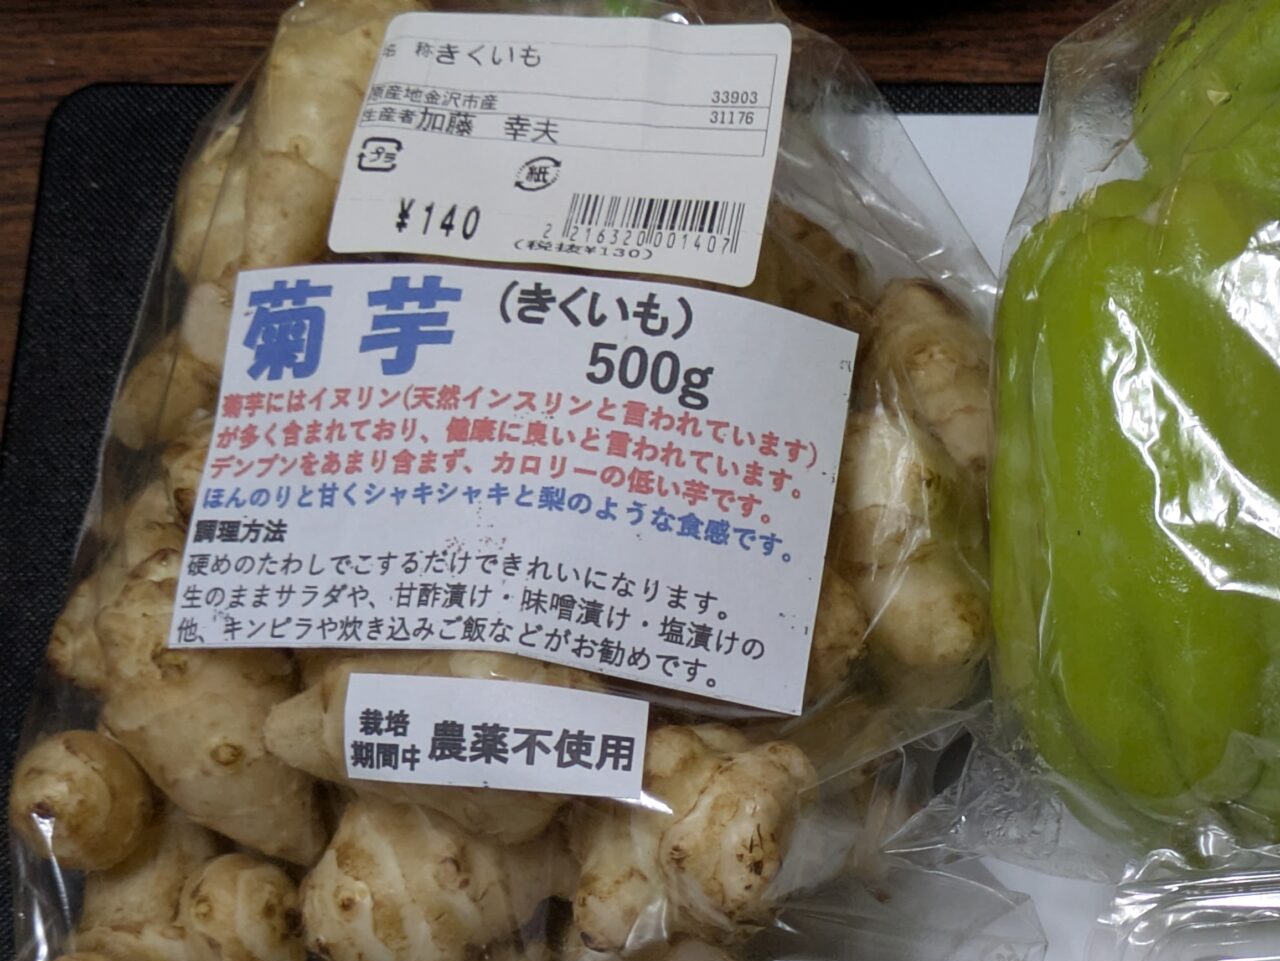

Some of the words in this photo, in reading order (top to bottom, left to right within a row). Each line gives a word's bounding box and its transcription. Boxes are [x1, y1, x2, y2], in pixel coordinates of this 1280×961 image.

[434, 43, 542, 68] きくいも
[709, 110, 755, 126] 31176
[711, 90, 759, 105] 33903
[525, 164, 550, 183] 紙
[395, 197, 482, 241] ¥140
[242, 275, 463, 381] 菊芋
[499, 280, 693, 340] (きくいも)
[585, 341, 715, 411] 500g
[193, 518, 288, 544] 調理方法
[201, 481, 792, 564] ほんのりと甘くシャキシャキと梨のような食感です。
[187, 550, 728, 621] 硬めのたわしでこするだけできれいになります。
[350, 741, 421, 772] 期間中
[428, 720, 636, 773] 農薬不使用
